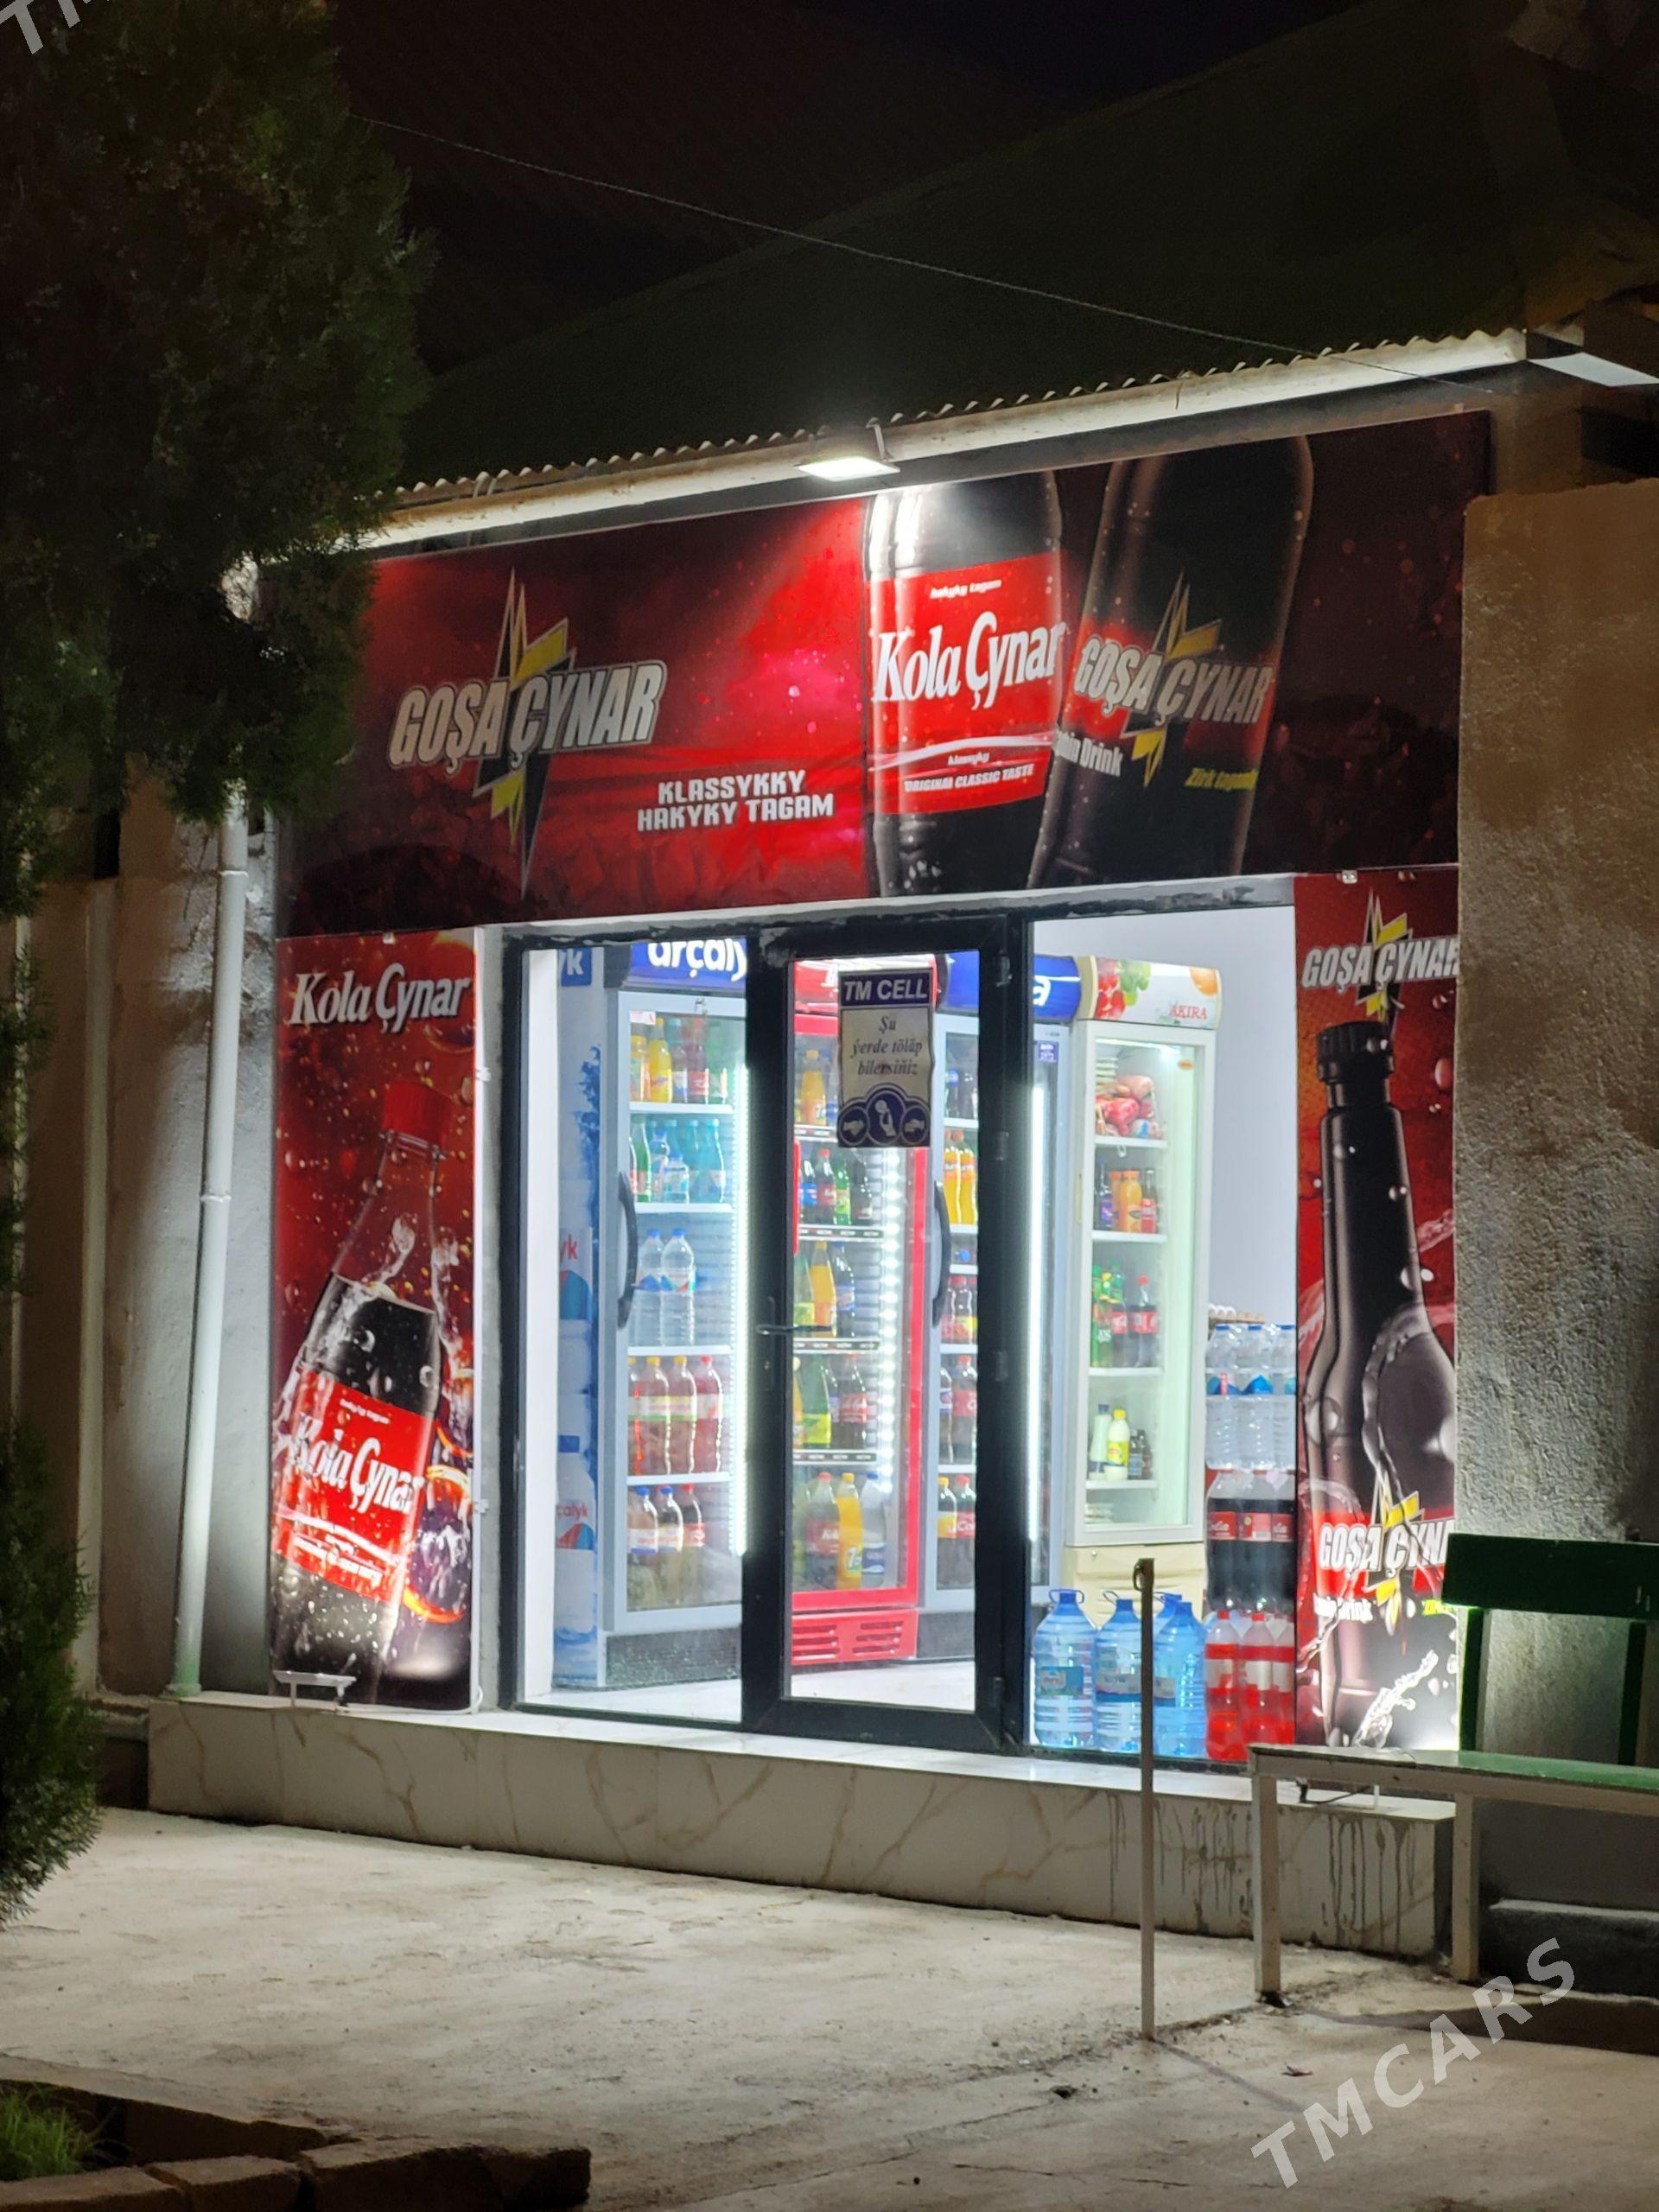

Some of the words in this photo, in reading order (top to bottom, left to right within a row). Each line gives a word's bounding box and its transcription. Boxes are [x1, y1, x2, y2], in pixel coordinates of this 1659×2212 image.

[871, 625, 963, 702] Kola
[965, 611, 1067, 710] Çynar
[1073, 636, 1164, 715] GOŞA
[1156, 658, 1274, 727] ÇYNAR
[389, 680, 510, 775] GOŞA
[508, 663, 665, 770] ÇYNAR
[658, 769, 806, 805] KLASSYKKY
[954, 768, 1001, 788] CLASSIC
[1001, 763, 1036, 781] TASTE
[637, 800, 739, 832] HAKYKY
[745, 793, 835, 823] TAGAM
[843, 980, 873, 1002] TM
[876, 978, 928, 1000] CELL
[1301, 944, 1374, 993] GOŞA
[289, 969, 372, 1026] Kola
[374, 963, 472, 1034] Çynar
[878, 1015, 897, 1034] Şu
